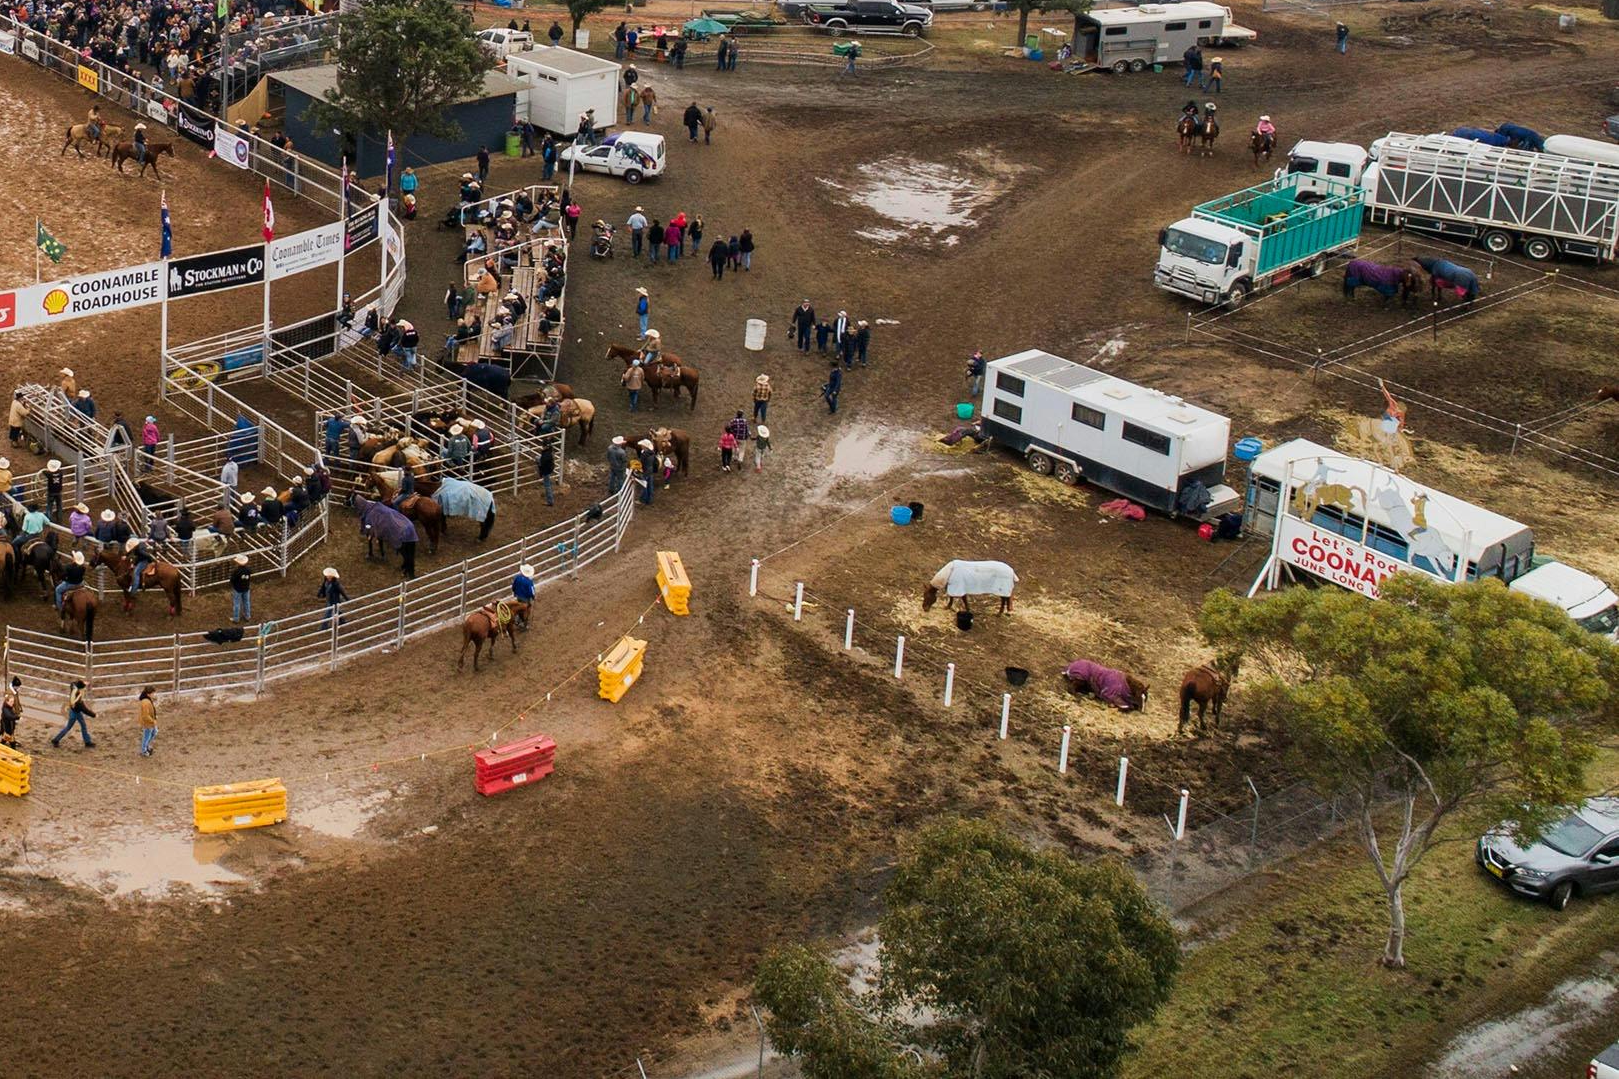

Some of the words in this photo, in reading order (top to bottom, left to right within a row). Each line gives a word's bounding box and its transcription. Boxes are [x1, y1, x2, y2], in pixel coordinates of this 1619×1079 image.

[80, 70, 96, 85] XXXX
[272, 238, 314, 262] Coonamble
[316, 230, 341, 249] Times
[71, 269, 159, 296] COONAMBLE
[184, 262, 240, 287] STOCKMAN
[72, 285, 158, 312] ROADHOUSE
[1312, 530, 1354, 556] Let's
[1364, 552, 1398, 573] Rod
[1293, 557, 1326, 575] JUNE
[1332, 573, 1365, 592] LONG
[1370, 587, 1381, 598] W
